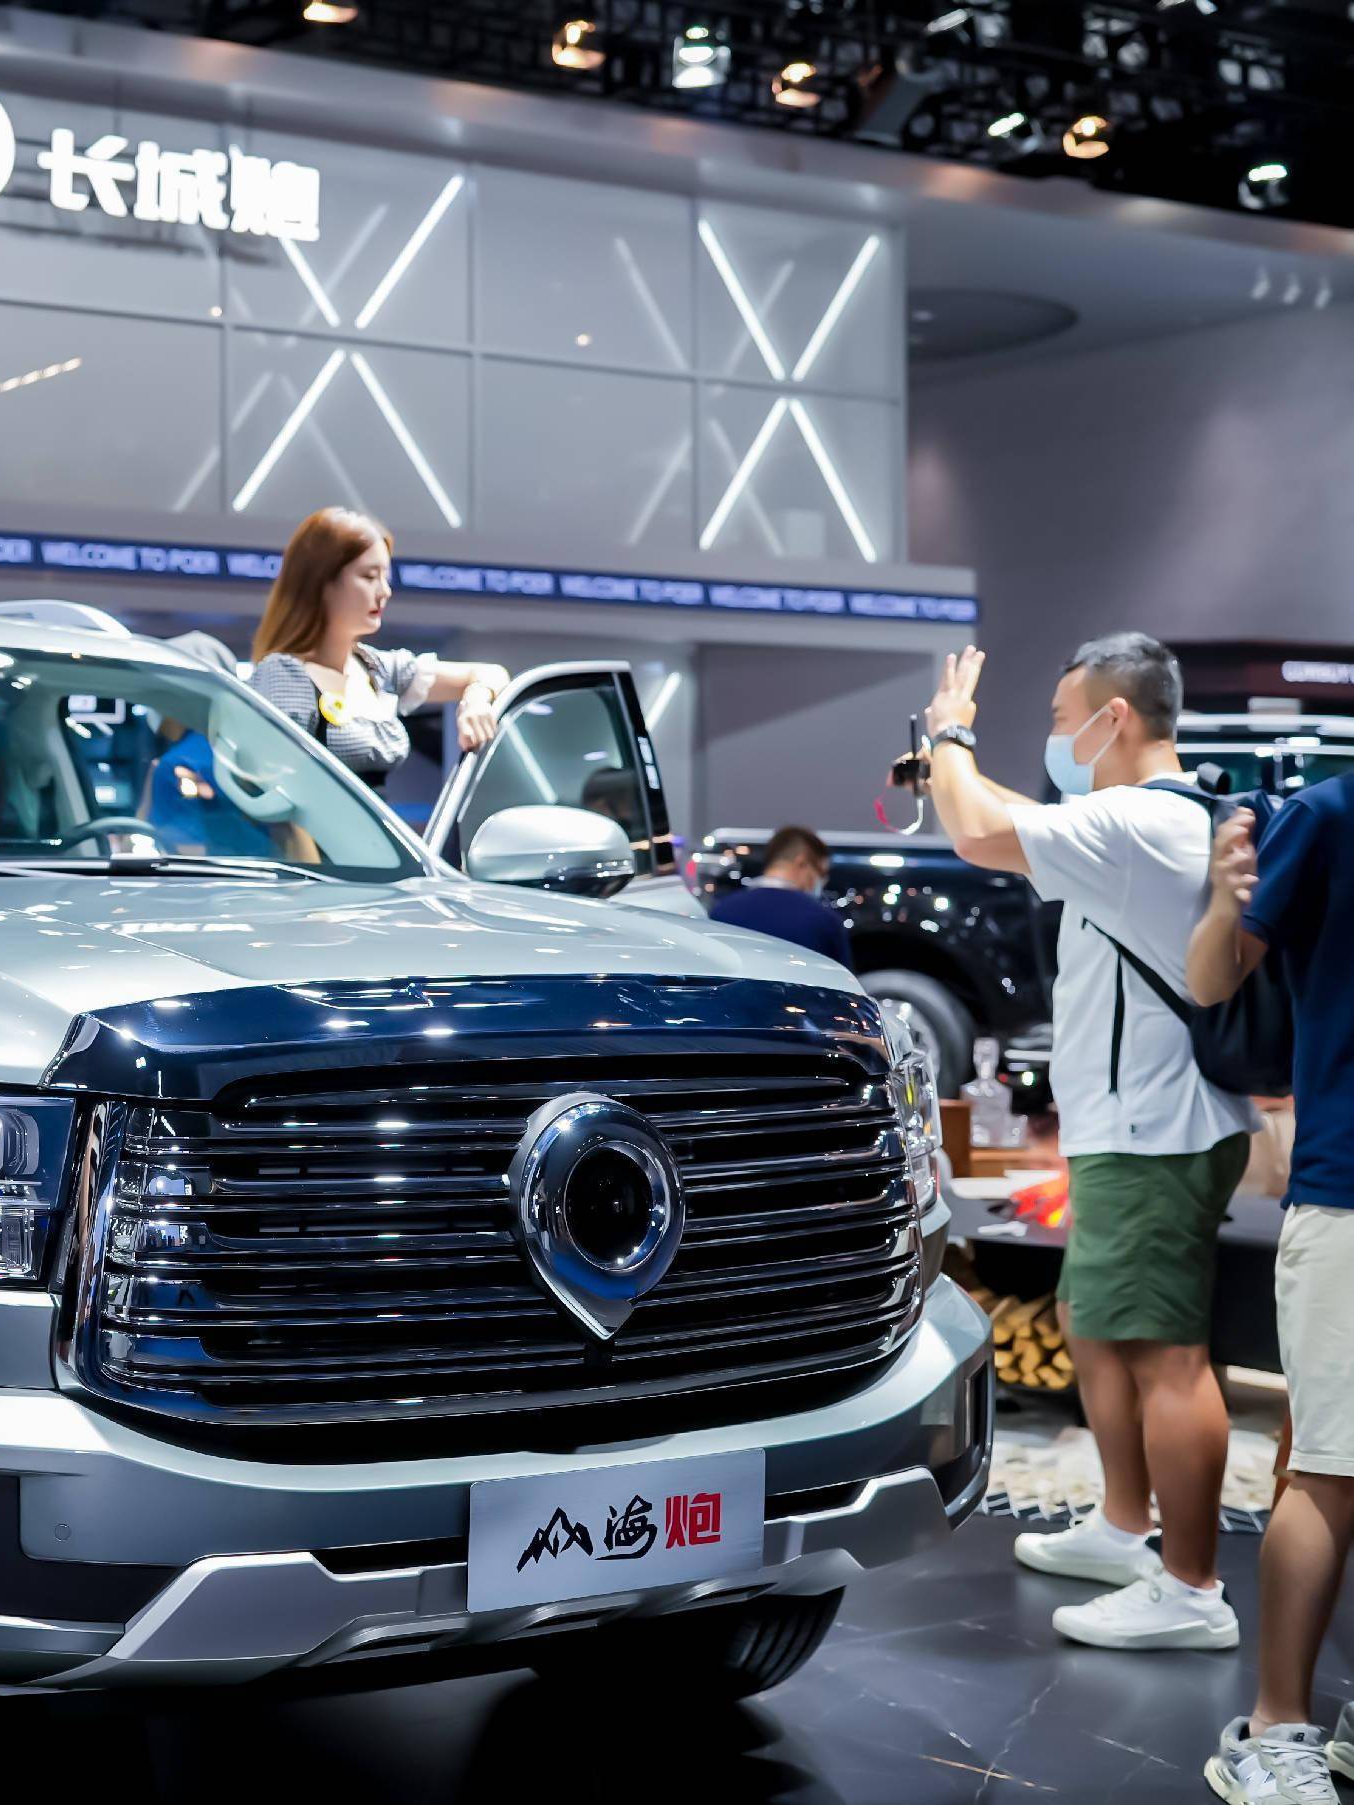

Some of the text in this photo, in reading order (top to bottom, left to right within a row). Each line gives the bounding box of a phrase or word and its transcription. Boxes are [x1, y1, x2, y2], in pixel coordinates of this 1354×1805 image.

[37, 127, 320, 241] 长城炮
[41, 541, 137, 571] WELCOME
[140, 546, 167, 572] TO
[516, 1492, 721, 1574] 山海炮
